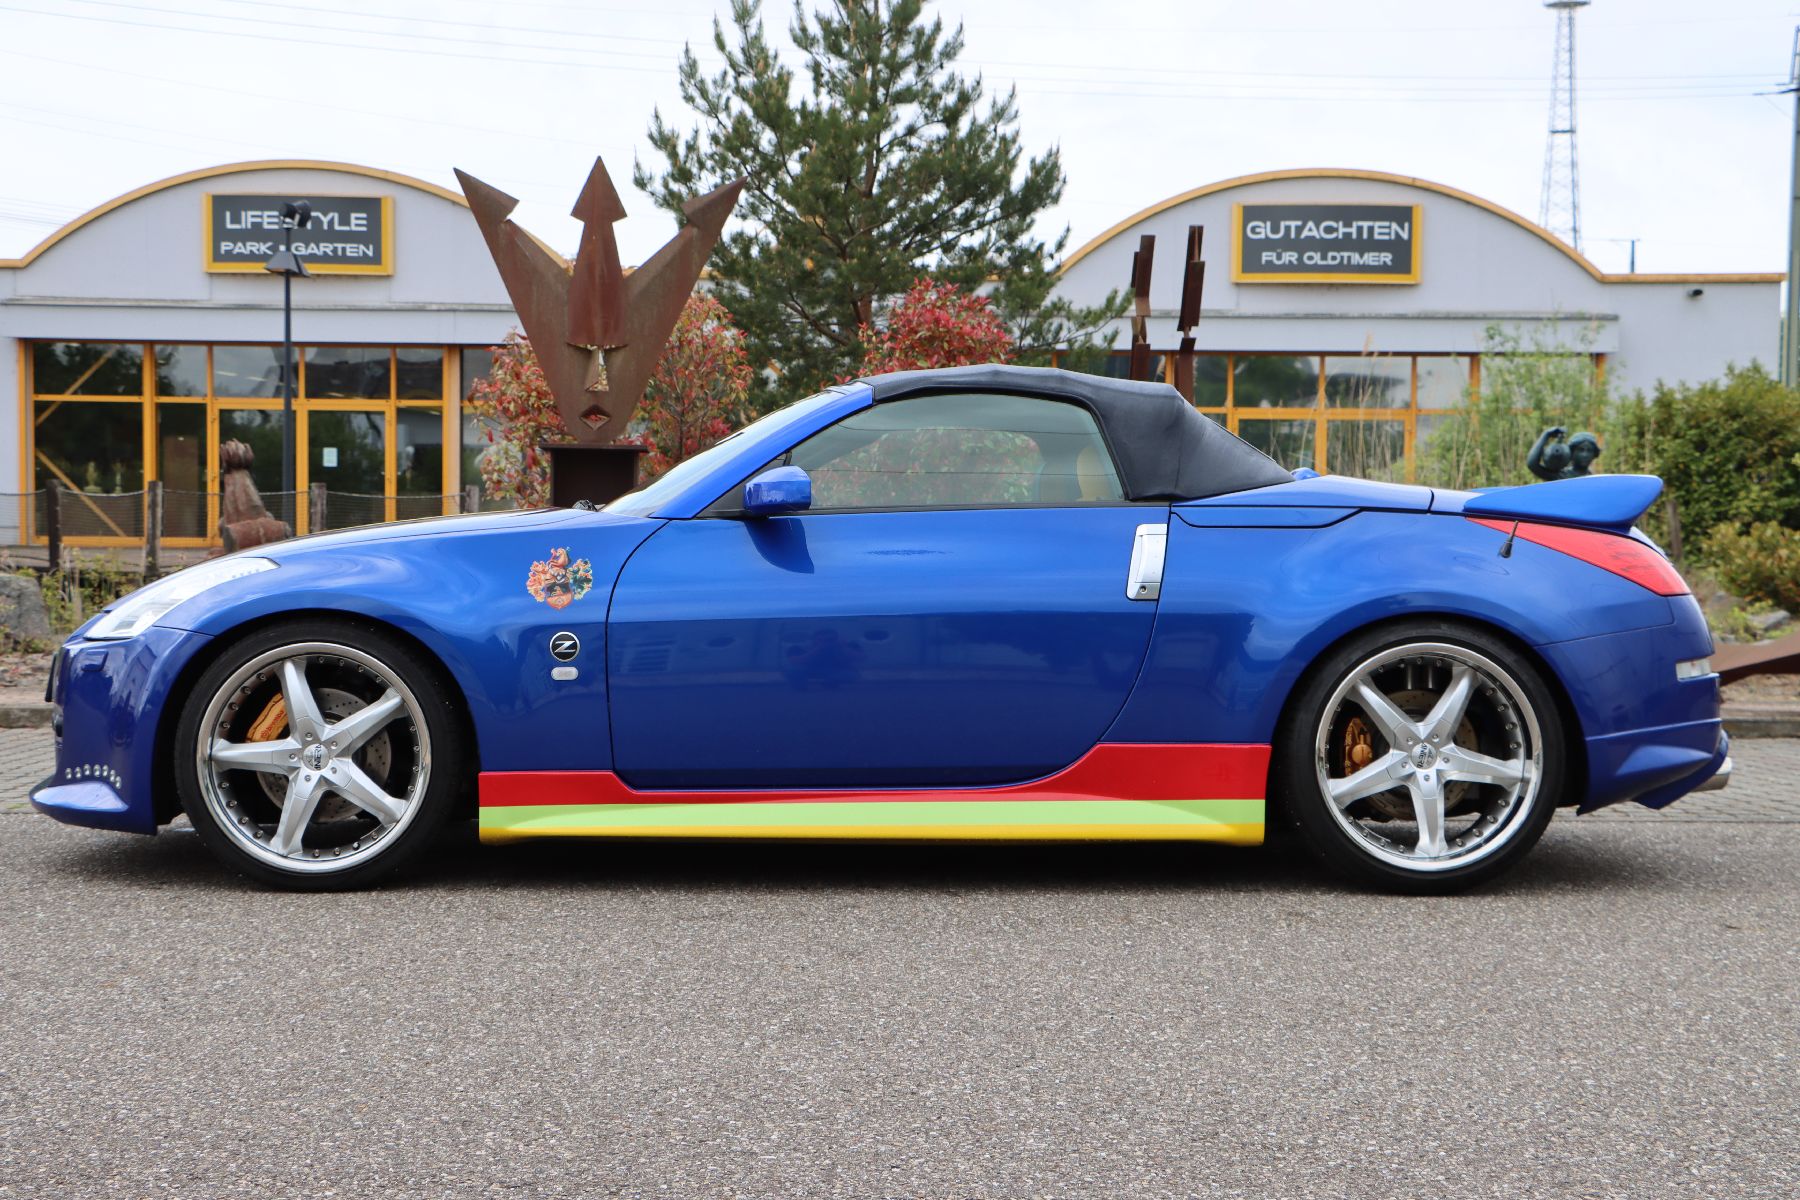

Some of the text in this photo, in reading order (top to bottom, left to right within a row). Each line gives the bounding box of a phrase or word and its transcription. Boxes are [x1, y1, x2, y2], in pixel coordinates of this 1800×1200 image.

[1246, 220, 1409, 240] GUTACHTEN
[220, 241, 374, 257] PARK GARTEN
[1261, 248, 1393, 266] FÜR OLDTIMER
[554, 640, 576, 653] Z
